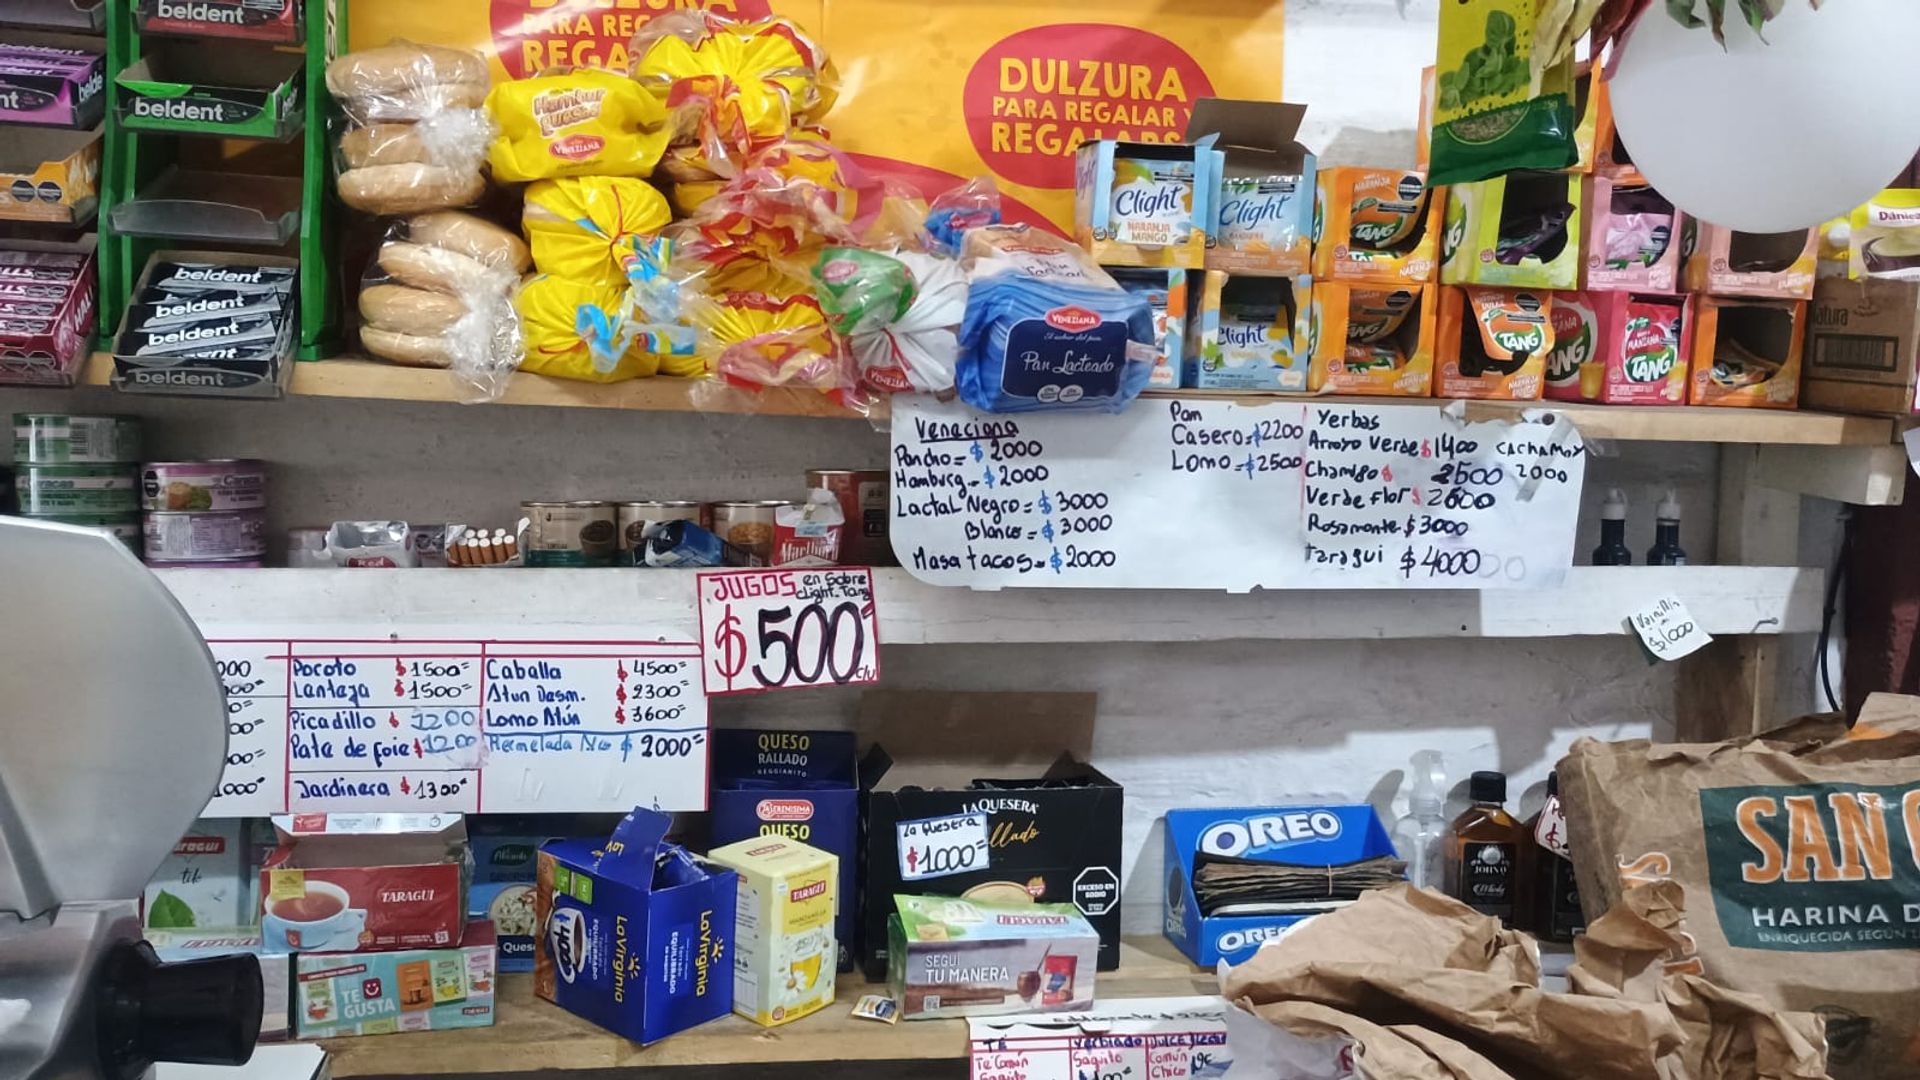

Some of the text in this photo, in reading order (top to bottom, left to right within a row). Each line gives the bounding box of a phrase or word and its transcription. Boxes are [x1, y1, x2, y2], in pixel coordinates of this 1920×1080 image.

[158, 0, 244, 24] beldent
[1000, 58, 1187, 103] DULZURA
[135, 97, 223, 121] beldent
[992, 97, 1057, 120] PARA
[1065, 101, 1177, 127] REGALAR
[1116, 186, 1183, 218] Clight
[1219, 196, 1291, 230] Clight
[1355, 224, 1396, 240] TANG
[174, 268, 262, 283] beldent
[155, 296, 245, 318] beldent
[1051, 312, 1096, 326] VENEZIANA
[149, 323, 239, 346] beldent
[1499, 332, 1539, 351] TANG
[1020, 350, 1115, 376] Pan Lacteado
[1631, 354, 1670, 382] TANG
[135, 371, 224, 386] beldent
[1261, 419, 1303, 440] 2200
[1317, 409, 1380, 430] Yerbas
[970, 440, 984, 462] $
[990, 439, 1043, 461] 2000
[1369, 435, 1418, 456] Verde
[1435, 433, 1478, 459] 1400
[1172, 449, 1231, 473] Lomo
[1257, 453, 1302, 472] 2500
[999, 465, 1049, 487] 2000
[1515, 463, 1568, 483] 2000
[967, 495, 1020, 525] Negro
[1038, 490, 1052, 514] $
[1056, 491, 1109, 512] 3000
[1306, 485, 1366, 508] Verde
[965, 515, 1113, 543] Blanco $ 3000
[1404, 514, 1415, 538] $
[1420, 515, 1469, 537] 3000
[913, 546, 961, 570] Masa
[1050, 546, 1062, 574] $
[1065, 544, 1116, 568] 2000
[1400, 546, 1416, 578] $
[709, 573, 797, 600] JUGOS
[803, 574, 820, 585] en
[714, 604, 748, 692] $
[486, 659, 562, 680] Caballa
[290, 710, 376, 731] Picadillo
[486, 707, 538, 728] Lomo
[758, 734, 810, 752] QUESO
[758, 753, 808, 766] RALLADO
[978, 798, 1037, 815] QUESERA
[759, 824, 810, 841] QUESO
[922, 817, 980, 837] Quesera
[1202, 811, 1340, 858] OREO
[1736, 792, 1893, 884] SAN
[907, 846, 918, 873] $
[1751, 903, 1920, 927] HARINA D
[1757, 930, 1853, 945] ENRIQUECIDA
[926, 967, 1010, 984] TU MANERA
[341, 989, 361, 1004] TE
[344, 1000, 395, 1019] GUSTA
